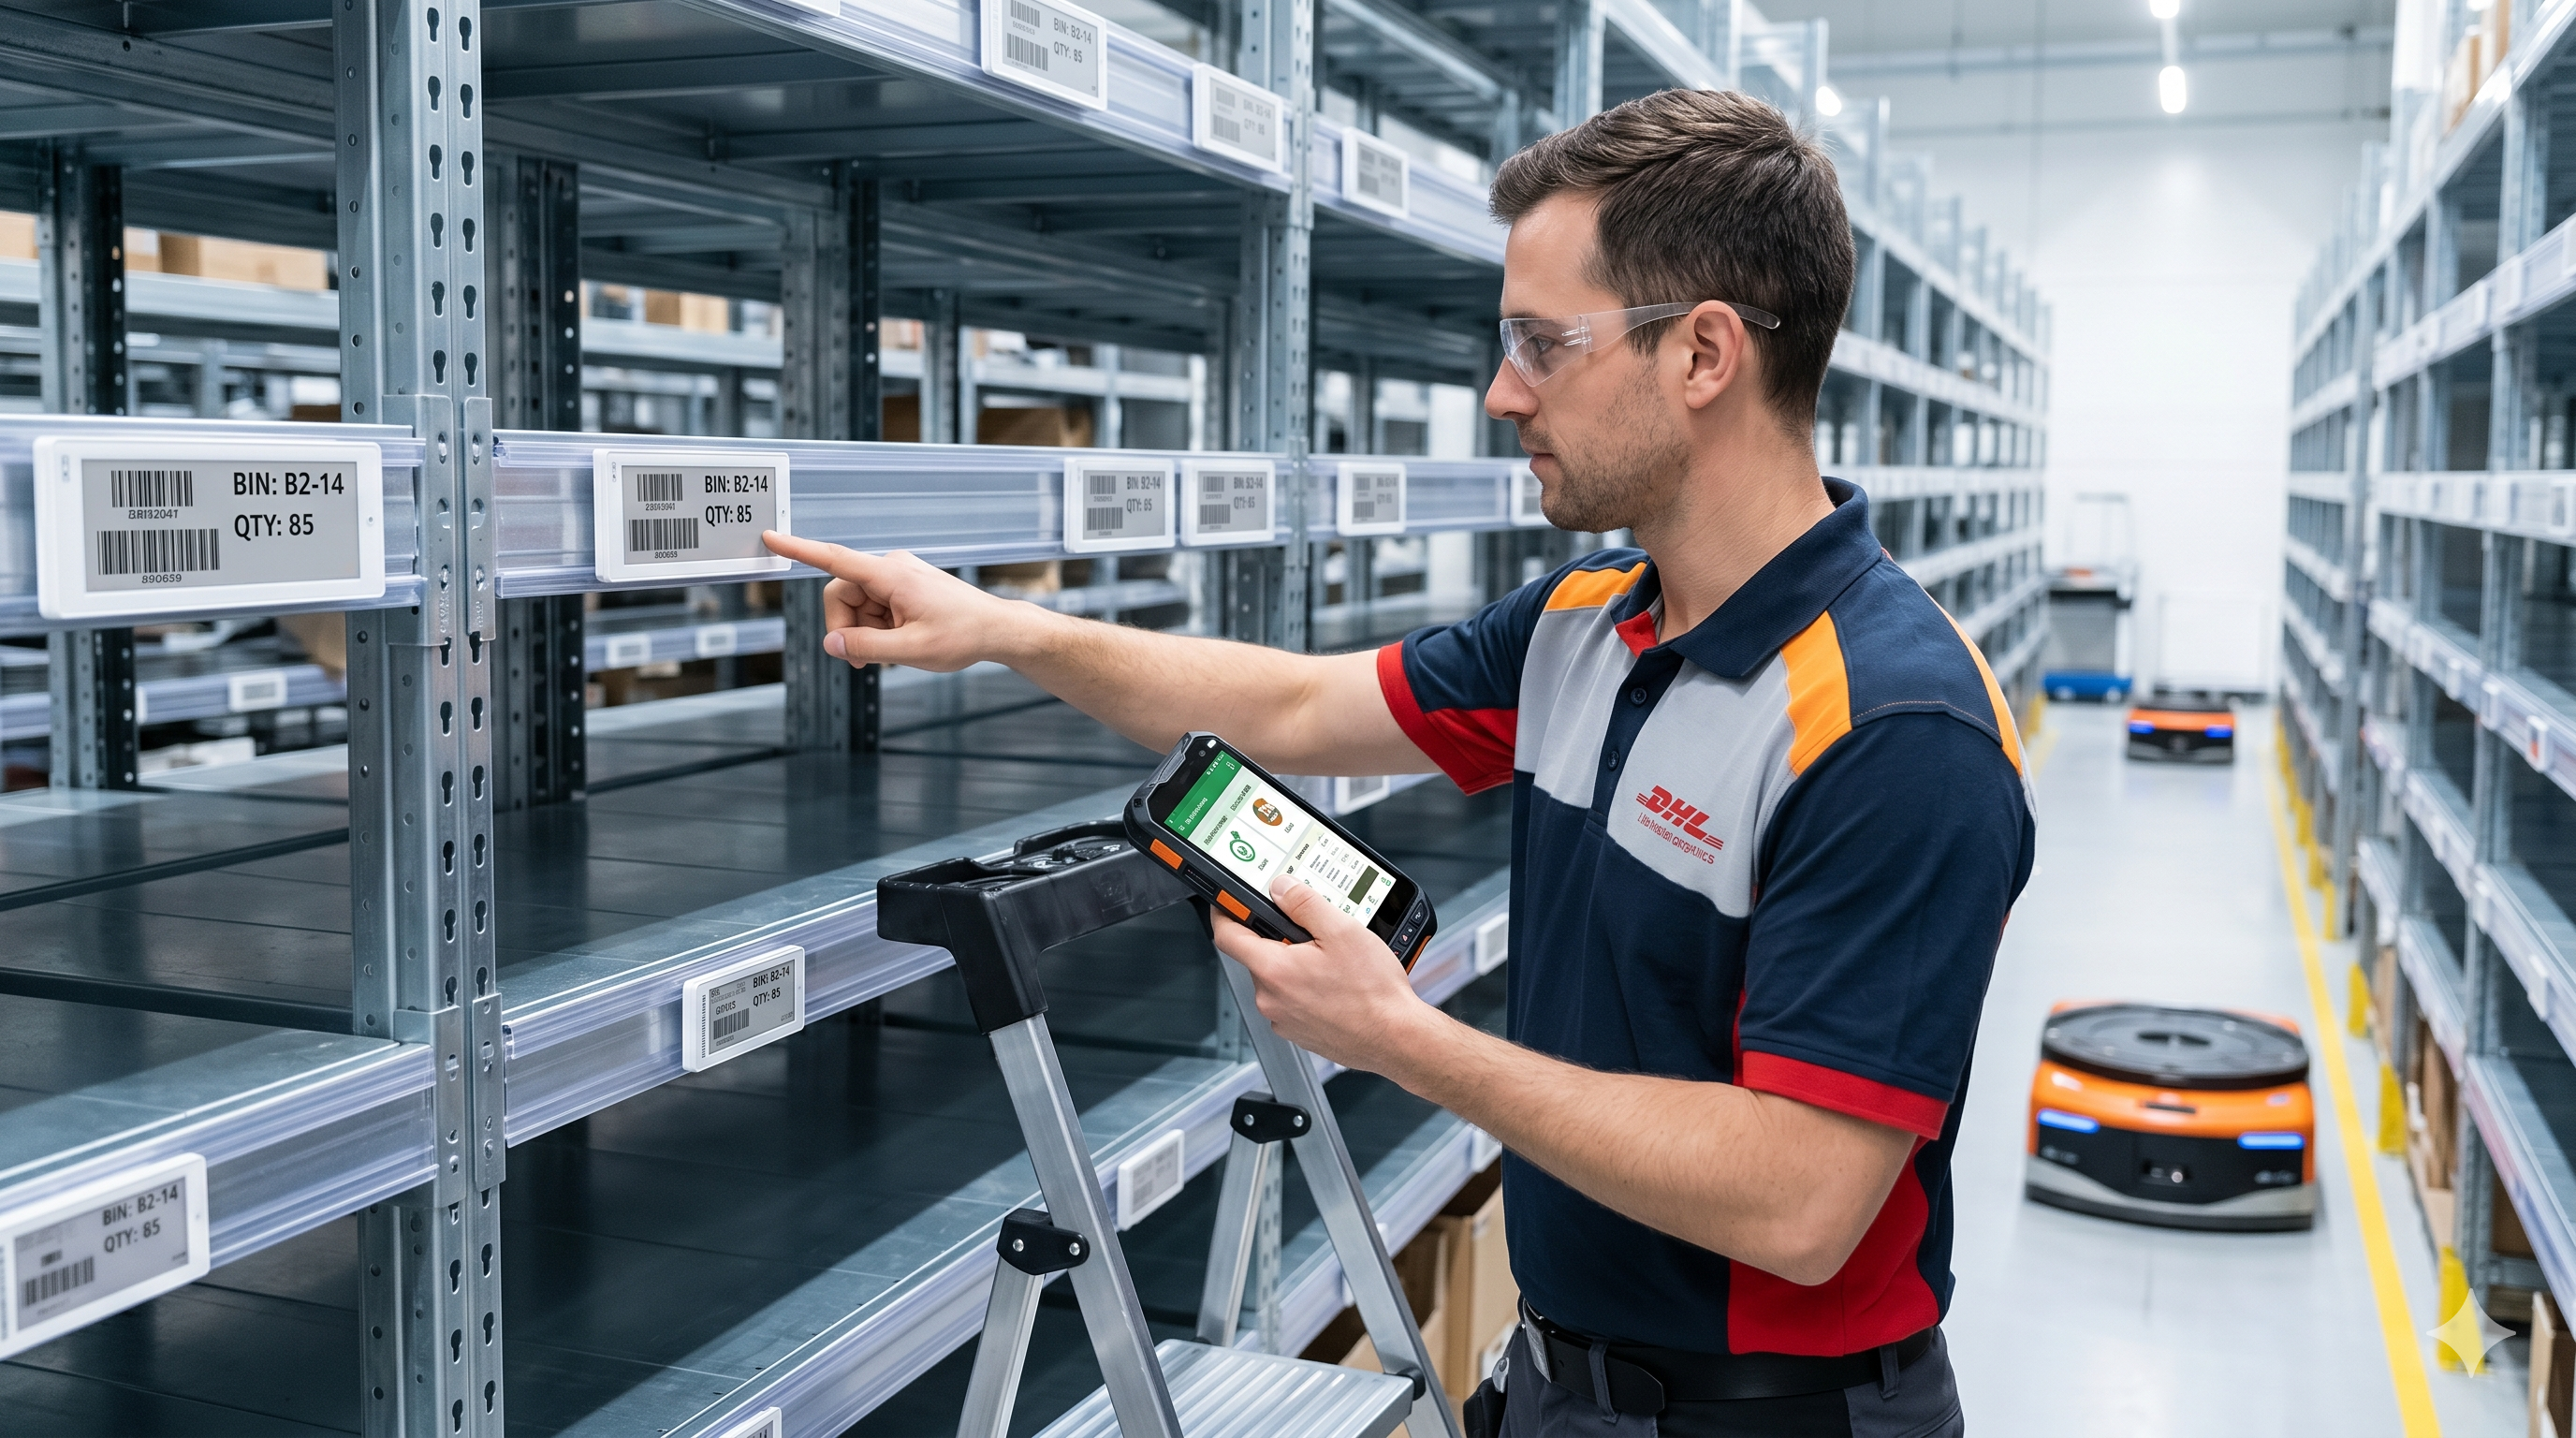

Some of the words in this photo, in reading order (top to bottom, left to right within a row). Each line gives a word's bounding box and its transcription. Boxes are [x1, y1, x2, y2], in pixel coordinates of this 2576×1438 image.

[1054, 18, 1069, 36] BIN:
[233, 472, 277, 495] BIN:
[285, 472, 344, 495] B2-14
[705, 476, 730, 493] BIN:
[734, 475, 768, 492] B2-14
[705, 506, 733, 527] QTY:
[737, 505, 753, 523] 85
[1126, 498, 1142, 514] QTY:
[234, 514, 282, 541] QTY:
[288, 513, 315, 536] 85
[141, 573, 183, 584] 890659
[1645, 785, 1710, 841] DHL
[753, 990, 770, 1007] QTY:
[771, 987, 781, 1000] 85
[102, 1202, 133, 1226] BIN:
[137, 1184, 179, 1214] B2-14
[104, 1227, 139, 1254] QTY:
[143, 1218, 161, 1239] 85
